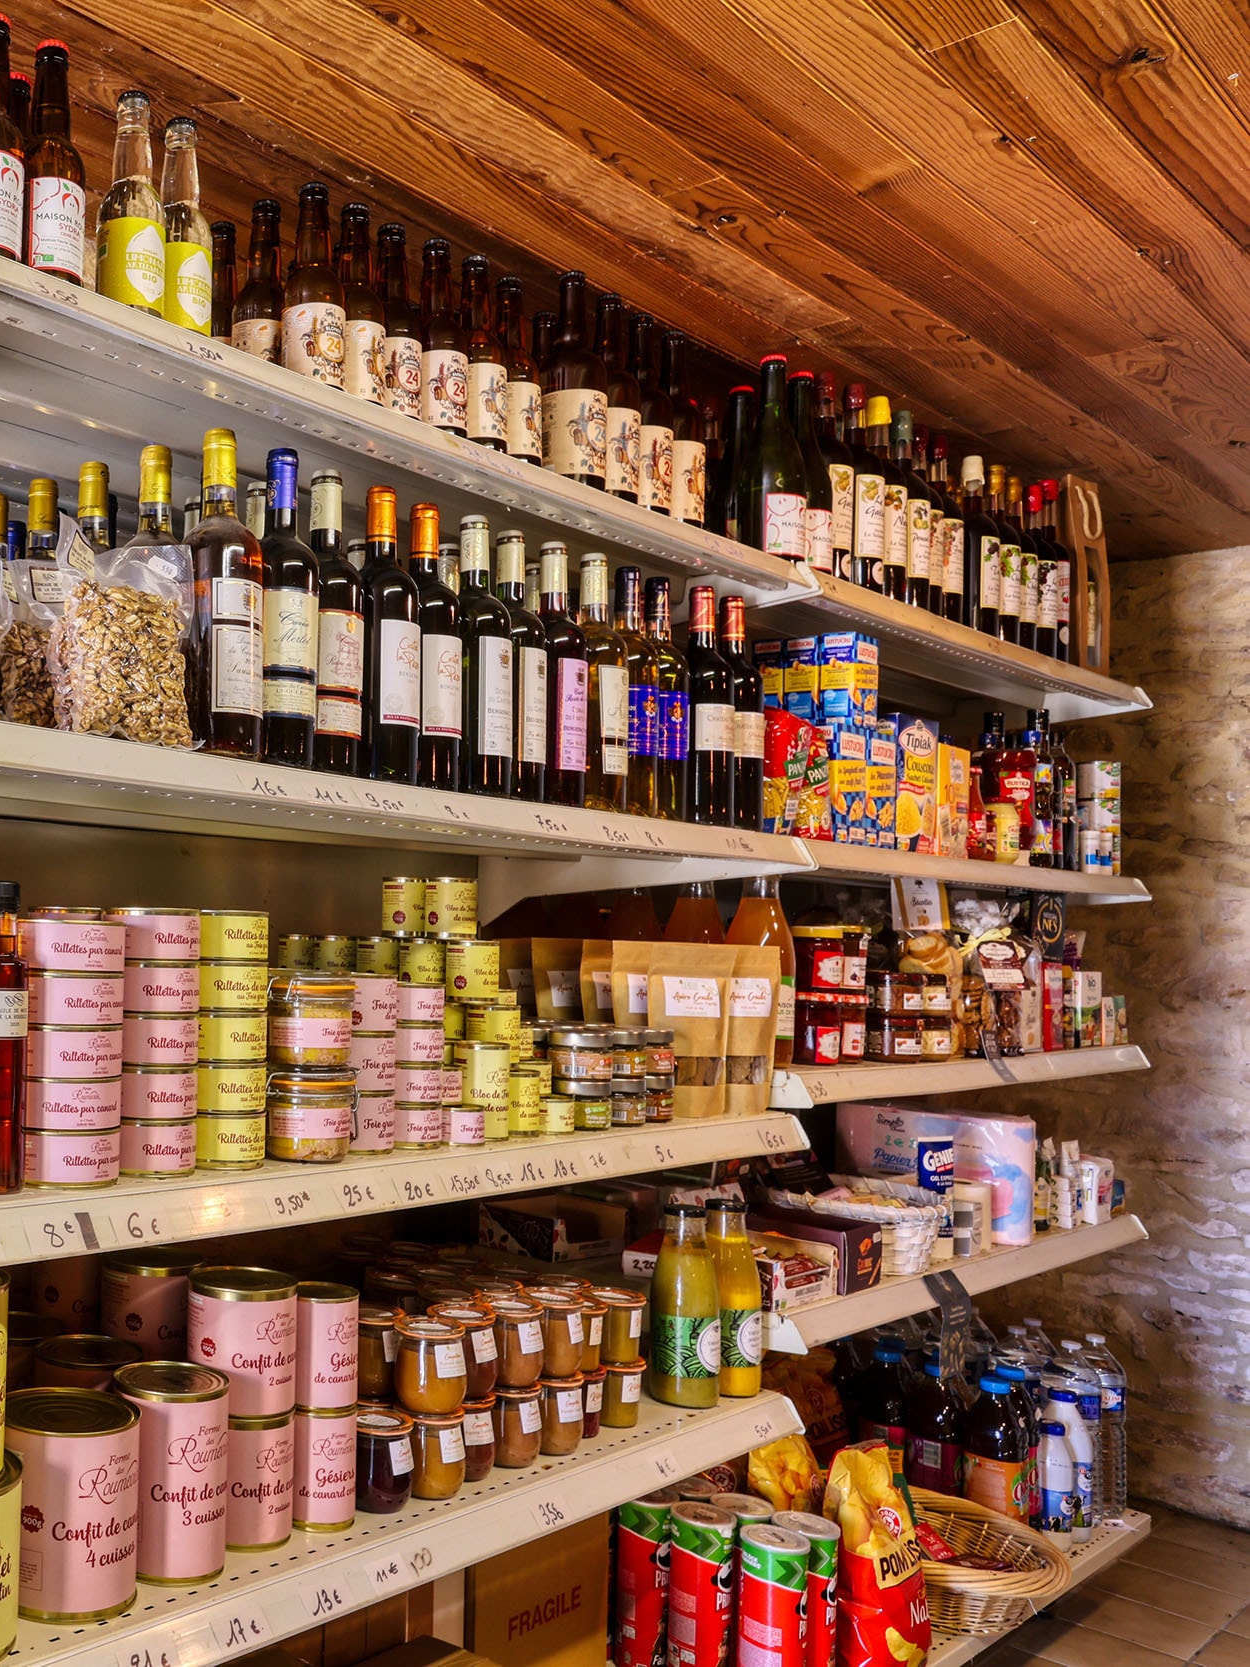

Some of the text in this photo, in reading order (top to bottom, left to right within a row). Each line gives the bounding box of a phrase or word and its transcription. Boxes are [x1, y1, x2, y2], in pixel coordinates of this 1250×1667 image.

[36, 213, 72, 224] MAISON
[142, 272, 158, 284] BIO
[192, 296, 206, 308] BIO
[326, 336, 342, 353] 24
[405, 369, 419, 386] 24
[452, 382, 466, 398] 24
[842, 739, 864, 754] LUSTUCRU
[905, 732, 932, 752] Tipiak
[154, 932, 190, 946] Rillettes
[224, 928, 258, 941] Rillettes
[51, 942, 88, 955] Rillettes
[88, 946, 102, 958] pur
[142, 984, 194, 1000] Rillettes pur
[214, 980, 259, 992] Rillettes de
[64, 997, 112, 1012] Rillettes pur
[148, 1036, 184, 1050] Rillettes
[230, 1032, 258, 1044] Rillettes
[412, 1042, 428, 1053] Foie
[59, 1051, 108, 1066] Rillettes pur
[362, 1058, 381, 1070] Foie
[147, 1091, 182, 1104] Rillettes
[470, 1088, 500, 1100] Bloc de
[42, 1102, 117, 1114] Rillettes canard
[364, 1118, 381, 1130] Foie
[232, 1352, 286, 1374] Confit de
[330, 1352, 357, 1370] Gésie
[314, 1370, 352, 1384] de canard
[198, 1424, 220, 1438] Ferme
[108, 1453, 130, 1468] Ferme
[116, 1466, 124, 1476] des
[150, 1483, 214, 1510] Confit de
[231, 1480, 286, 1503] Confit de
[298, 1486, 346, 1499] de canard
[22, 1516, 44, 1530] 900g
[182, 1506, 226, 1526] 3 cuisses
[52, 1519, 121, 1549] Confit de
[86, 1542, 136, 1569] 4 cuisses
[507, 1585, 582, 1642] FRAGILE
